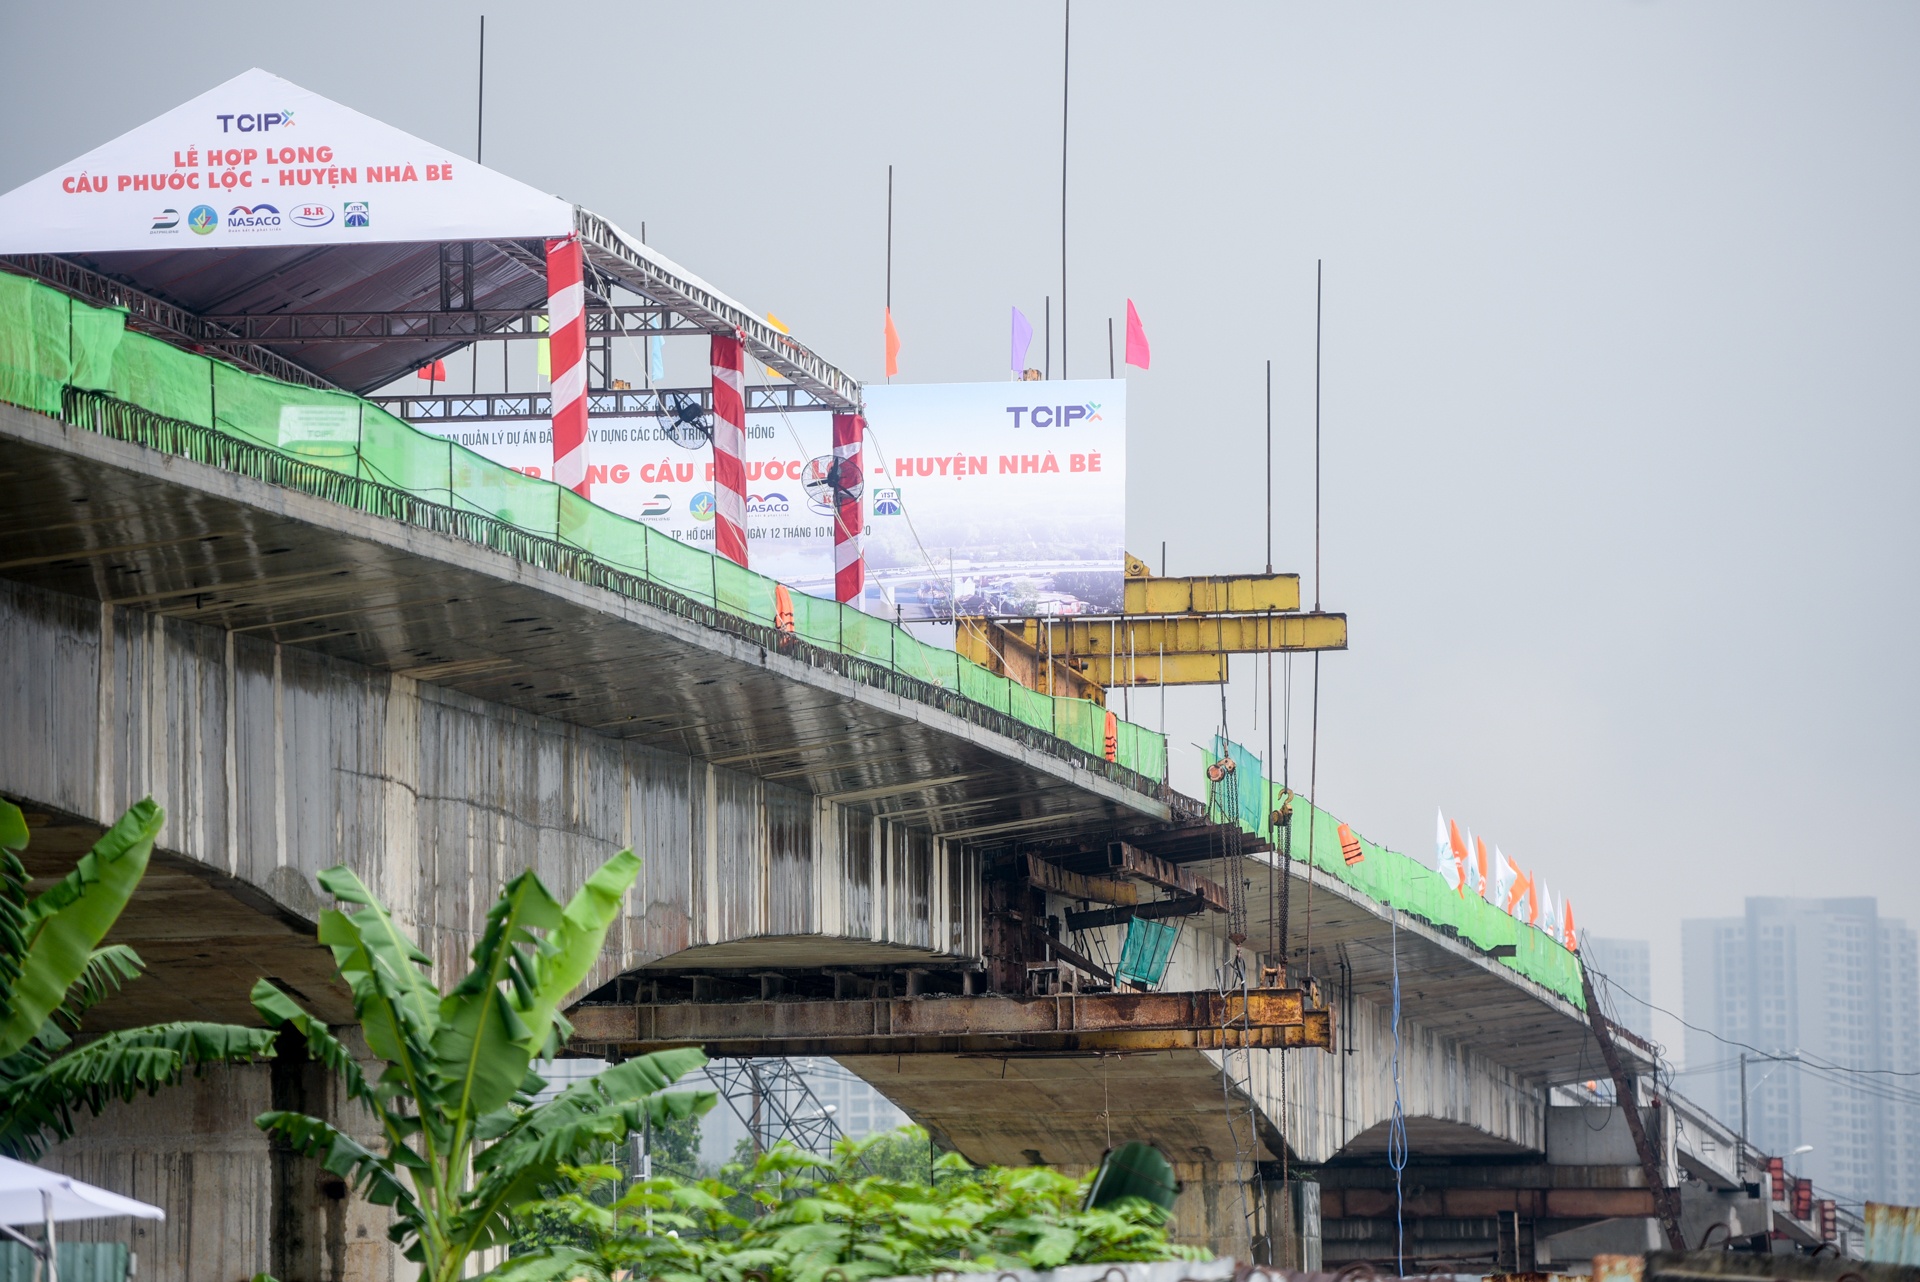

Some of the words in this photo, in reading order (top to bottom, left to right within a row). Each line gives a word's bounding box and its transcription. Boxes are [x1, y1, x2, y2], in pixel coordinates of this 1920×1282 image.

[216, 113, 282, 133] TCIP
[174, 144, 199, 168] LỄ
[207, 148, 258, 170] HỢP
[266, 146, 334, 164] LONG
[62, 171, 108, 193] CẦU
[118, 169, 199, 192] PHƯỚC
[208, 168, 252, 193] LỘC
[279, 164, 357, 189] HUYỆN
[366, 161, 418, 183] NHÀ
[426, 160, 453, 181] BÈ
[228, 216, 281, 227] NASACO
[303, 207, 324, 216] B.R
[1006, 405, 1086, 428] TCIP
[462, 429, 489, 446] QUẢN
[492, 430, 504, 445] LÝ
[507, 430, 520, 447] DỰ
[522, 430, 536, 445] ÁN
[539, 426, 553, 444] ĐẦ
[601, 428, 628, 445] DỰNG
[630, 426, 650, 442] CÁC
[746, 425, 775, 439] HÔNG
[640, 457, 694, 484] CẦU
[896, 452, 988, 481] HUYỆN
[999, 450, 1060, 474] NHÀ
[1070, 449, 1102, 472] BÈ
[771, 528, 780, 538] 12
[783, 525, 812, 538] THÁNG
[815, 526, 824, 537] 10
